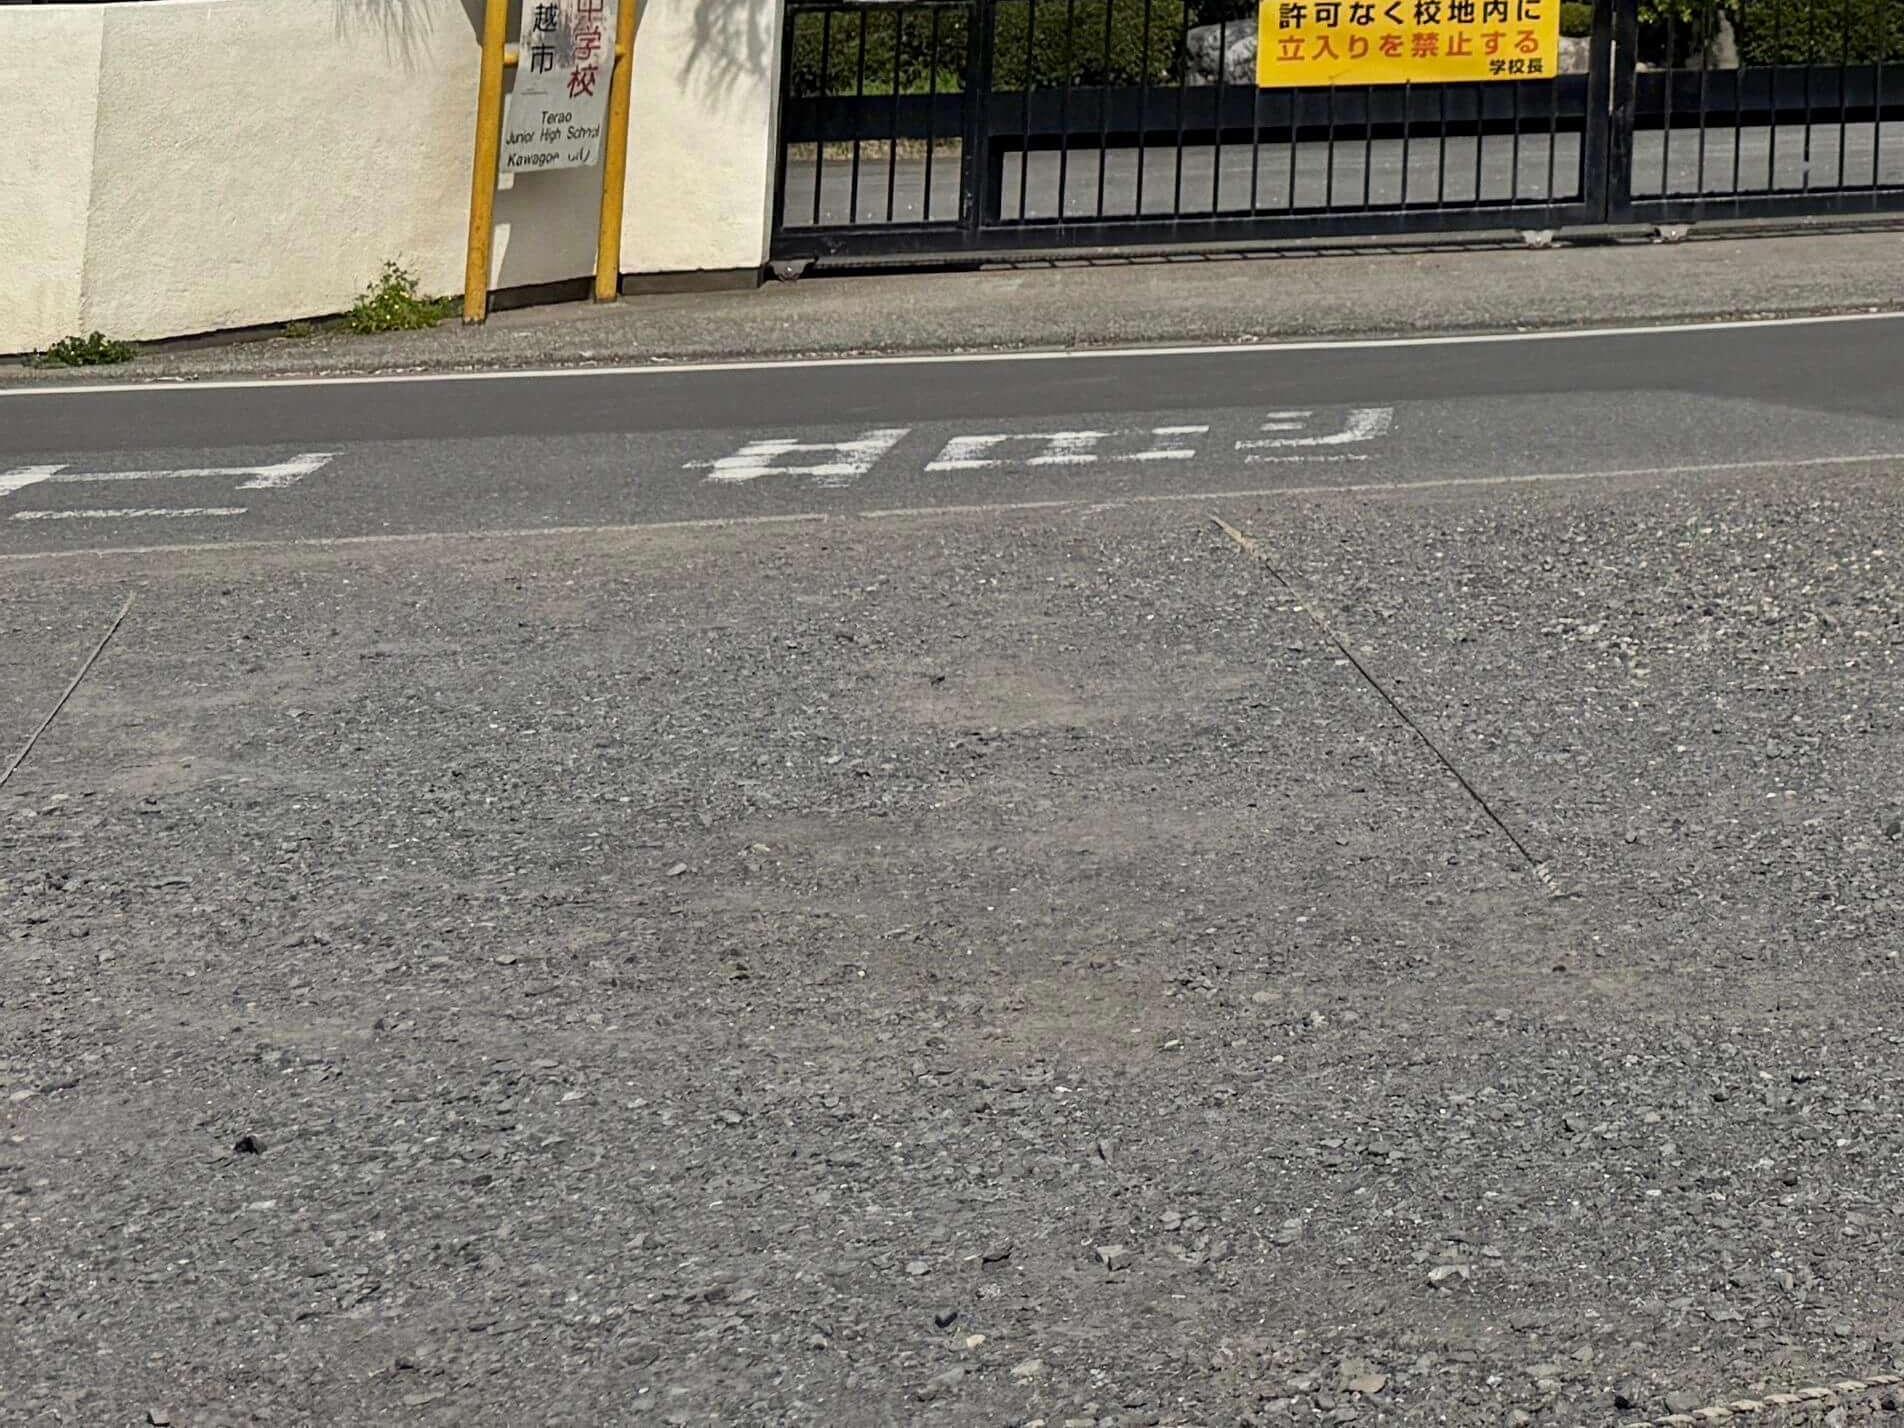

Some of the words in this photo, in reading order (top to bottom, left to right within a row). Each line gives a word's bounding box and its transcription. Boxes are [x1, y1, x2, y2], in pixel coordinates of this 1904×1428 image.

[1276, 29, 1540, 62] 立入りを禁止する
[1489, 58, 1544, 75] 学校長
[541, 110, 573, 125] Terao
[506, 129, 535, 145] Junior
[540, 128, 561, 144] High
